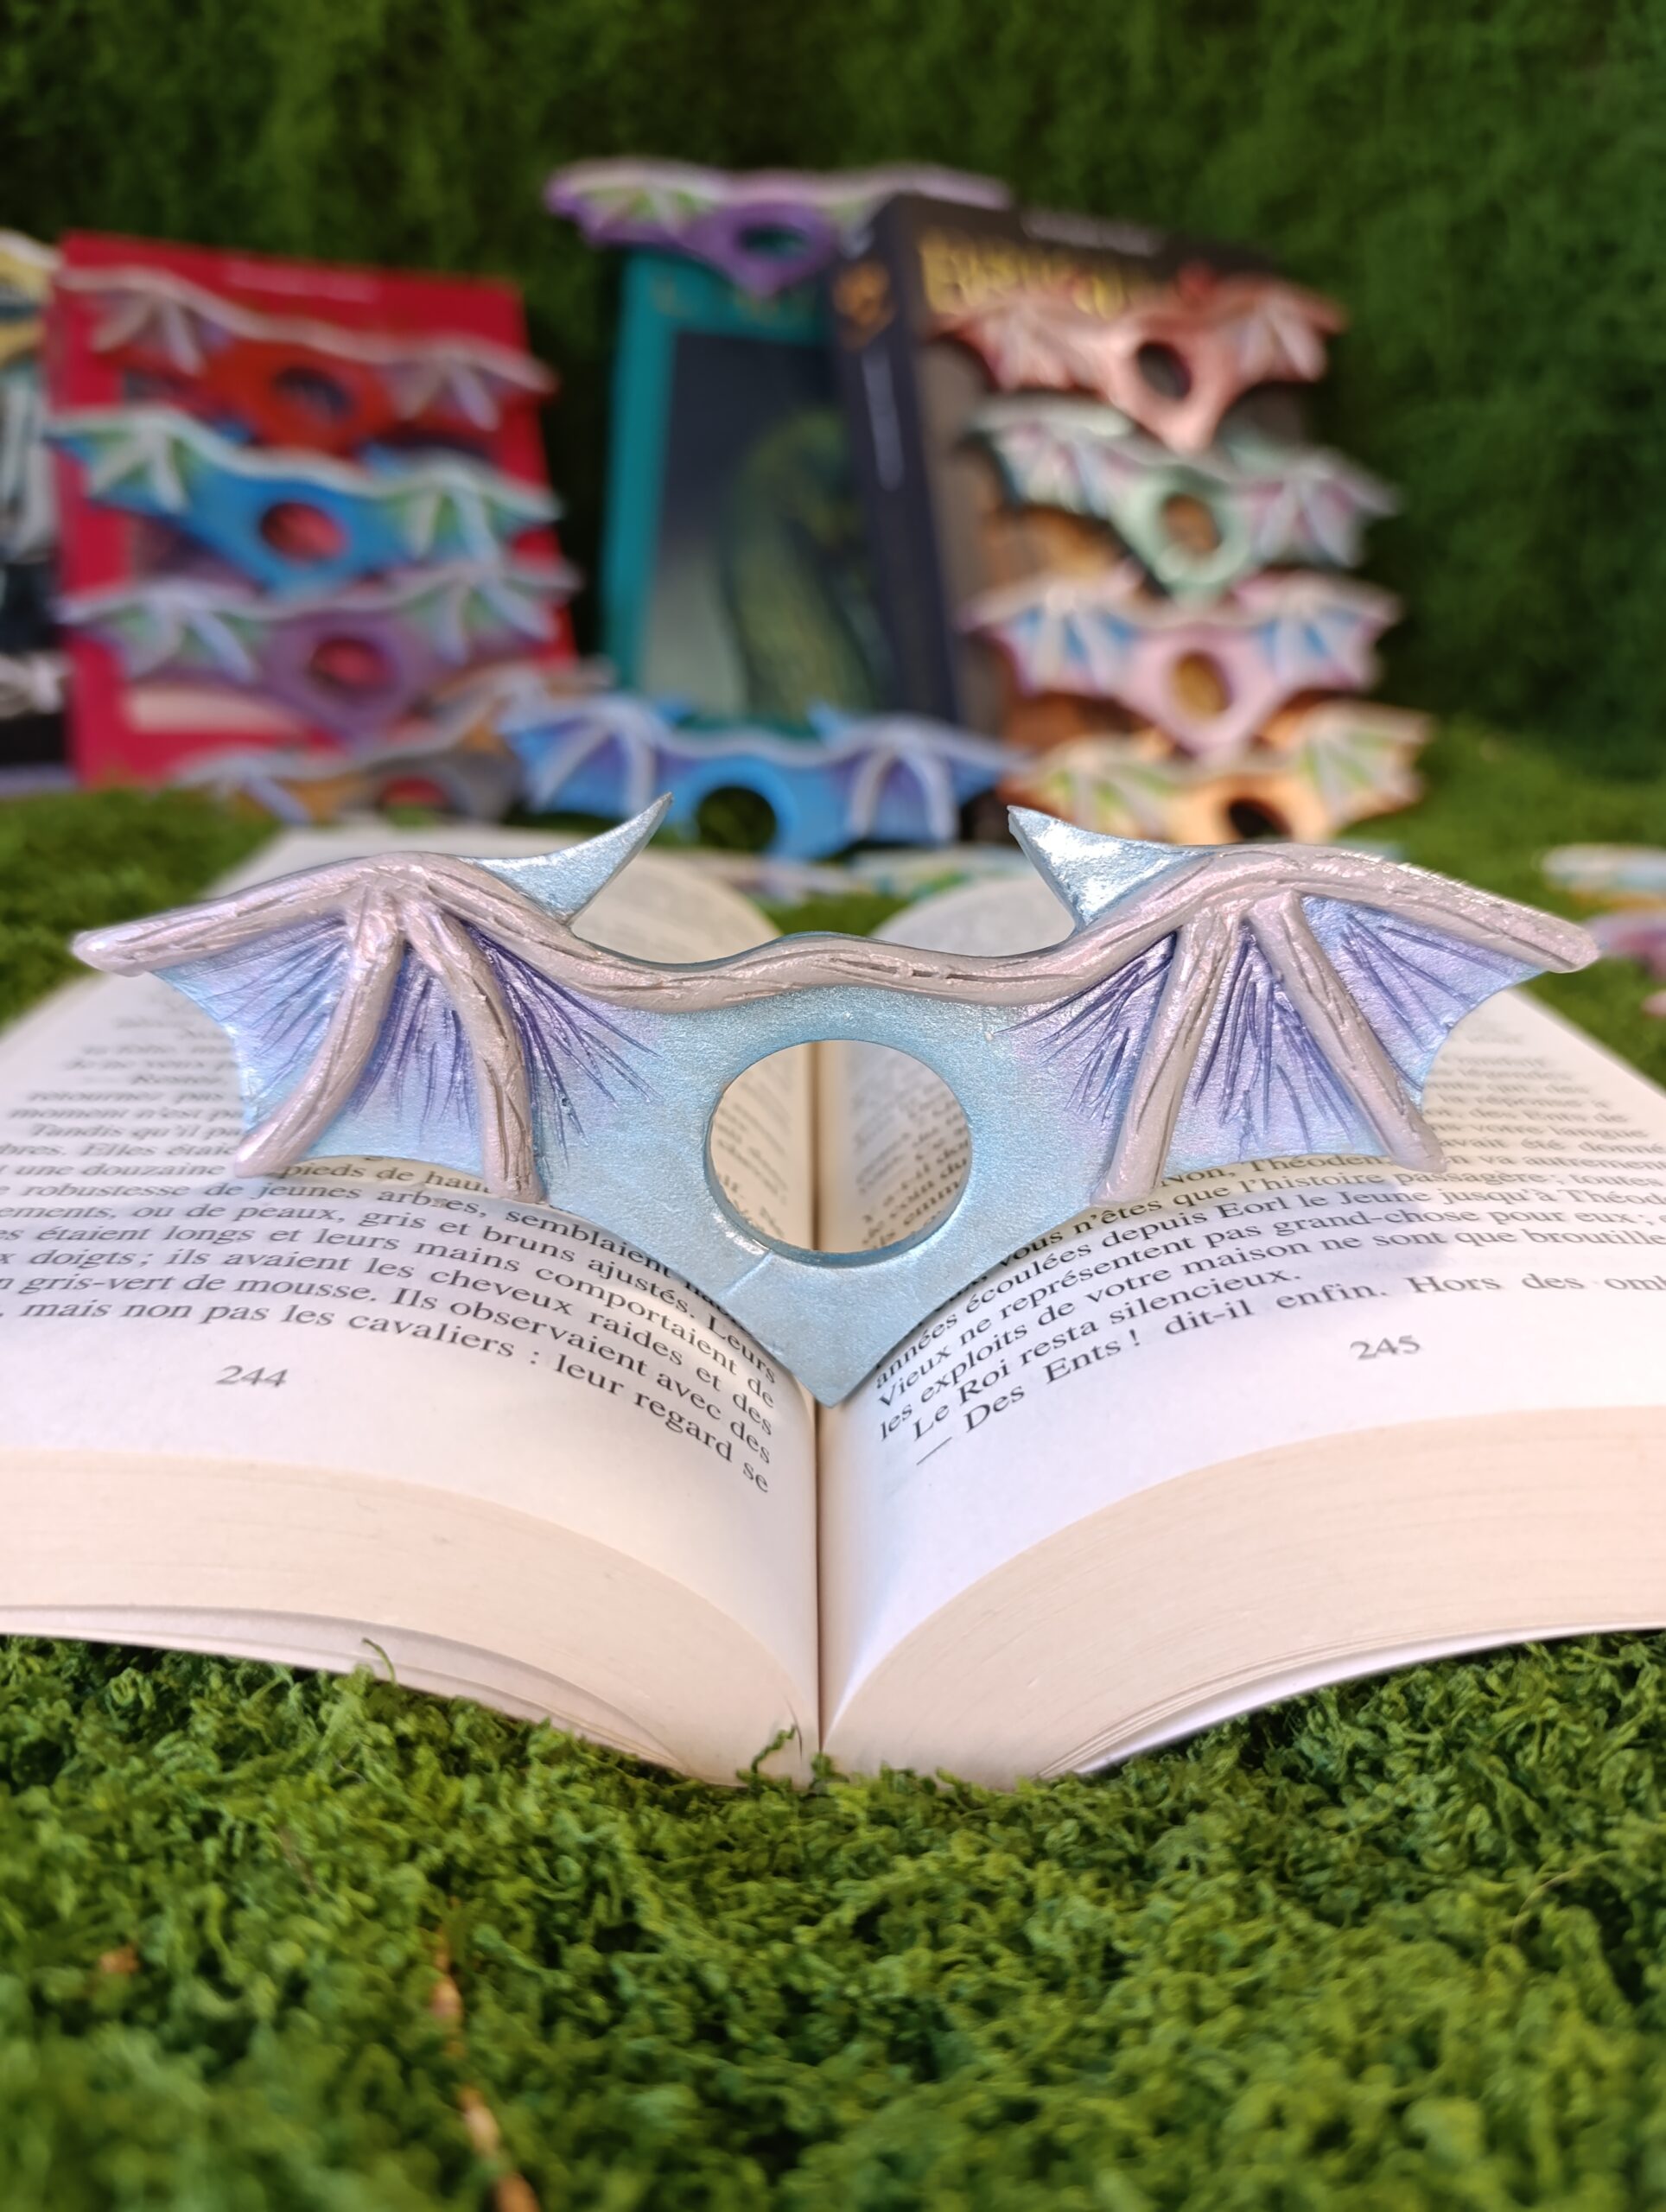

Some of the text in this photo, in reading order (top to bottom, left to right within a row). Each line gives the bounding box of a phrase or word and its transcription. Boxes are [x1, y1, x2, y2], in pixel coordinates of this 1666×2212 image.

[0, 1142, 238, 1156] bres. Elles étaie
[14, 1165, 73, 1176] une
[81, 1162, 226, 1176] douzaine
[278, 1163, 367, 1180] pieds
[376, 1167, 415, 1182] de
[30, 1123, 124, 1137] Tandis
[1438, 1137, 1508, 1149] avait
[1519, 1136, 1566, 1150] été
[1472, 1125, 1545, 1135] votre
[1547, 1123, 1649, 1141] langue
[1478, 1155, 1518, 1166] va
[21, 1182, 191, 1197] robustesse
[202, 1181, 245, 1197] de
[250, 1182, 363, 1200] jeunes
[505, 1209, 672, 1279] semblaient
[999, 1230, 1064, 1268] vous
[1171, 1185, 1231, 1208] que
[1238, 1173, 1386, 1194] l'histoire
[1567, 1173, 1666, 1188] toutes
[0, 1203, 777, 1384] ements, ou de peaux, gris et bruns ajustés. Leurs
[34, 1224, 154, 1242] étaient
[161, 1224, 257, 1246] longs
[269, 1228, 304, 1243] et
[313, 1228, 401, 1250] leurs
[413, 1242, 521, 1273] mains
[534, 1267, 738, 1376] comportaient
[747, 1376, 775, 1409] de
[165, 1248, 212, 1266] ils
[222, 1250, 353, 1271] avaient
[363, 1257, 415, 1279] les
[429, 1268, 575, 1317] cheveux
[587, 1311, 684, 1366] raides
[695, 1365, 722, 1392] et
[731, 1392, 773, 1436] des
[874, 1187, 1666, 1390] années écoulées depuis Eorl le Jeune jusqu'à Théod
[878, 1344, 953, 1408] Vieux
[957, 1316, 993, 1347] ne
[999, 1236, 1197, 1320] représentent
[1202, 1224, 1263, 1249] pas
[1272, 1207, 1481, 1236] grand-chose
[1487, 1209, 1567, 1225] pour
[880, 1228, 1666, 1442] les exploits de votre maison ne sont que broutille
[1350, 1334, 1422, 1361] 245
[17, 1272, 177, 1294] gris-vert
[181, 1273, 227, 1292] de
[233, 1278, 378, 1302] mousse.
[390, 1287, 439, 1311] Ils
[448, 1300, 648, 1377] observaient
[656, 1371, 722, 1421] avec
[729, 1421, 771, 1465] des
[18, 1299, 114, 1319] mais
[118, 1302, 194, 1319] non
[199, 1304, 271, 1325] pas
[280, 1303, 336, 1326] les
[347, 1313, 516, 1358] cavaliers
[555, 1352, 626, 1397] leur
[633, 1395, 734, 1464] regard
[742, 1460, 771, 1495] se
[215, 1365, 289, 1389] 244
[912, 1268, 1301, 1442] Le Roi resta silencieux.
[963, 1384, 1026, 1434] Des
[1164, 1298, 1255, 1336] dit-il
[1275, 1282, 1388, 1310] enfin.
[1405, 1275, 1504, 1294] Hors
[1521, 1273, 1587, 1291] des
